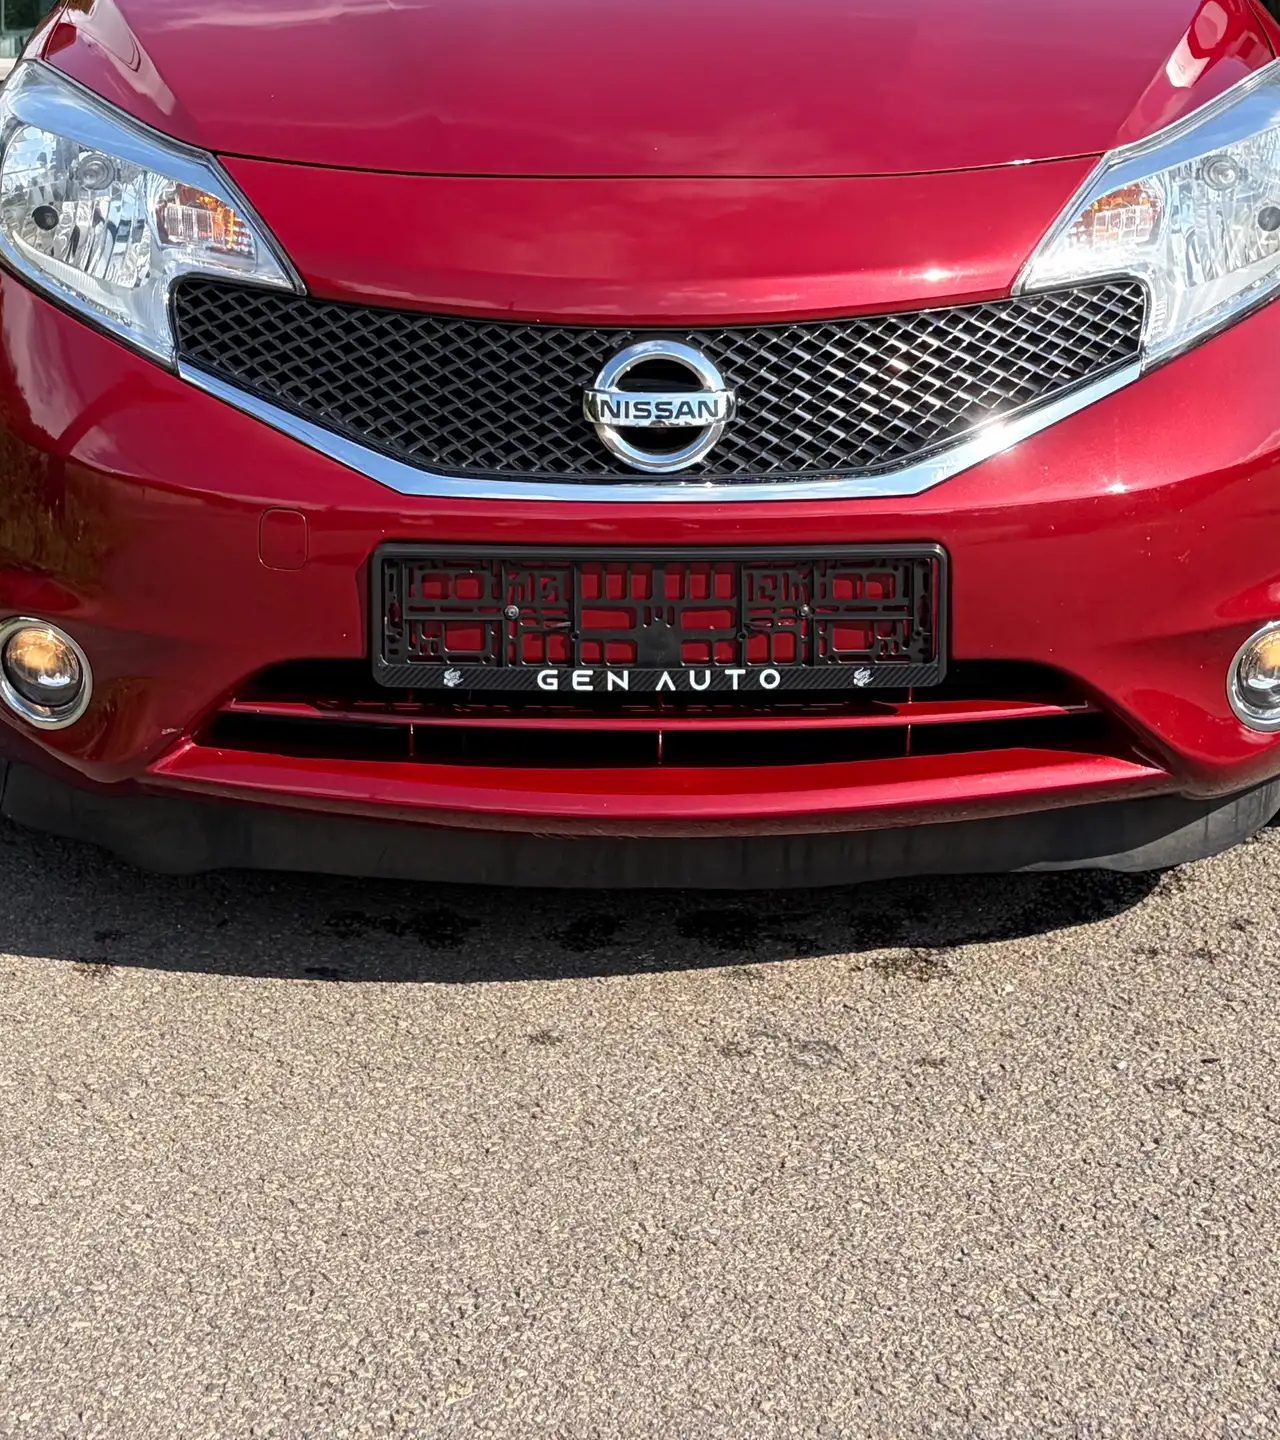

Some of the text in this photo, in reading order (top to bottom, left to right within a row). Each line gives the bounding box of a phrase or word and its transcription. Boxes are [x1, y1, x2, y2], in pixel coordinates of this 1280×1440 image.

[600, 400, 719, 420] NISSAN
[536, 668, 782, 692] GEN AUTO
